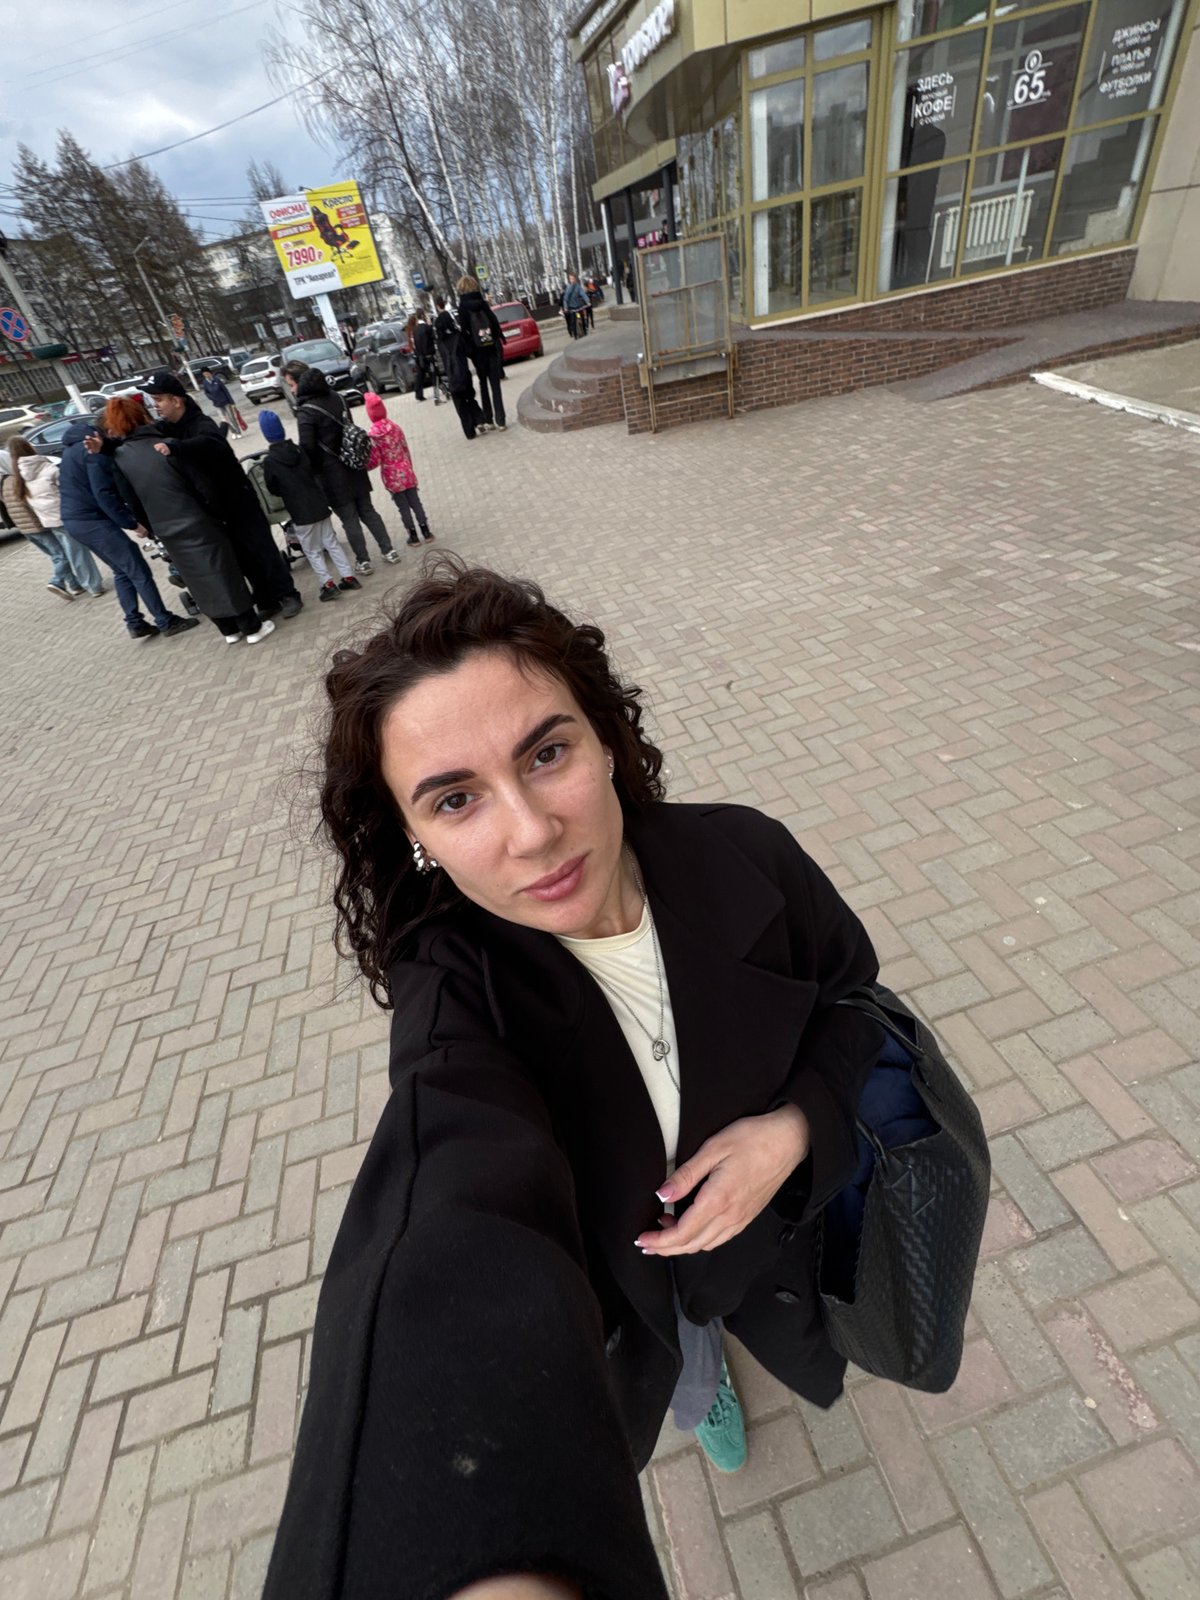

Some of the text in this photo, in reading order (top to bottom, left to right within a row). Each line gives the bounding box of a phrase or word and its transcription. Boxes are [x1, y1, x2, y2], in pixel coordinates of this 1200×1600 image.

[916, 71, 954, 92] ЗДЕСЬ
[1014, 70, 1046, 104] 65
[1099, 71, 1152, 93] ФУТБОЛКИ
[914, 95, 953, 118] КОФЕ
[269, 203, 306, 219] ОФИСМАГ
[286, 246, 315, 267] 7990
[293, 276, 307, 286] ТРК
